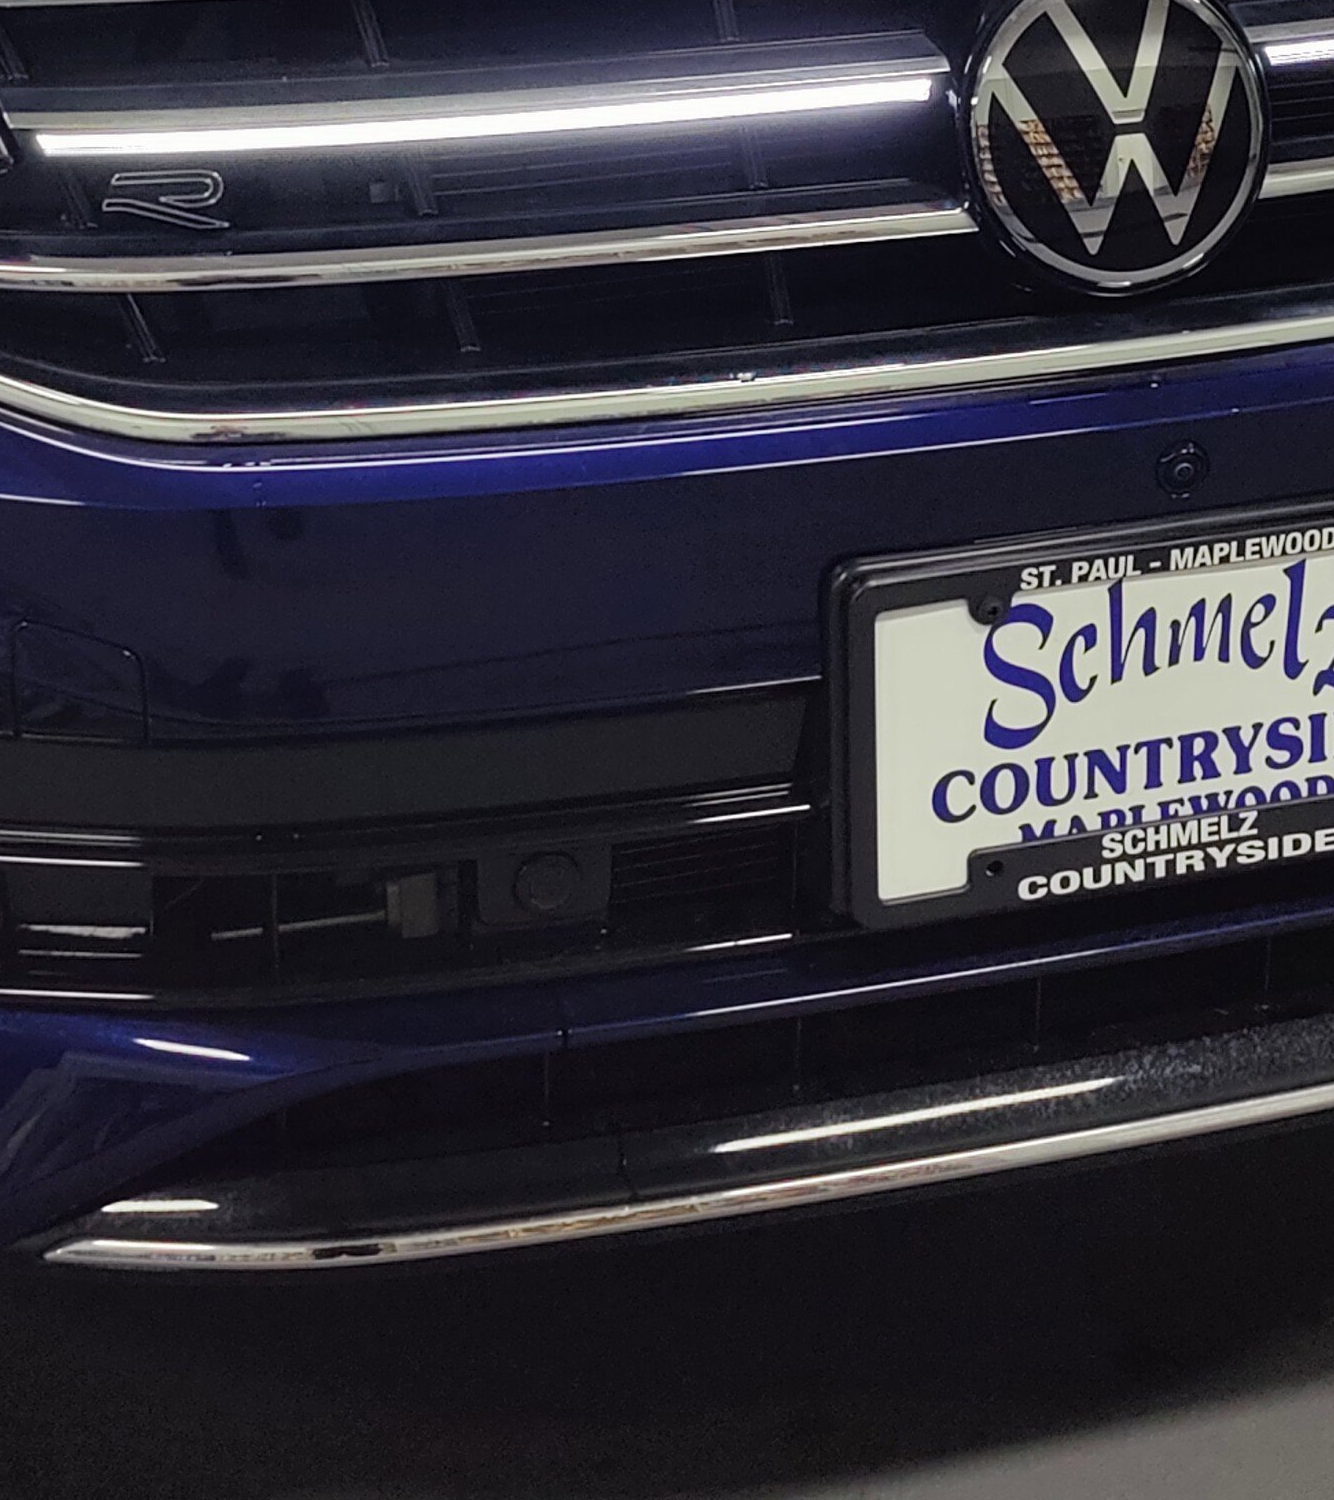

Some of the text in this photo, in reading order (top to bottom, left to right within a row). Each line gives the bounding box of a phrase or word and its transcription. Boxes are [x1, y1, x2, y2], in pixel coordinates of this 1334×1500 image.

[102, 169, 230, 229] R
[1020, 564, 1063, 590] ST.
[1071, 554, 1142, 583] PAUL
[1101, 811, 1259, 859] SCHMELZ
